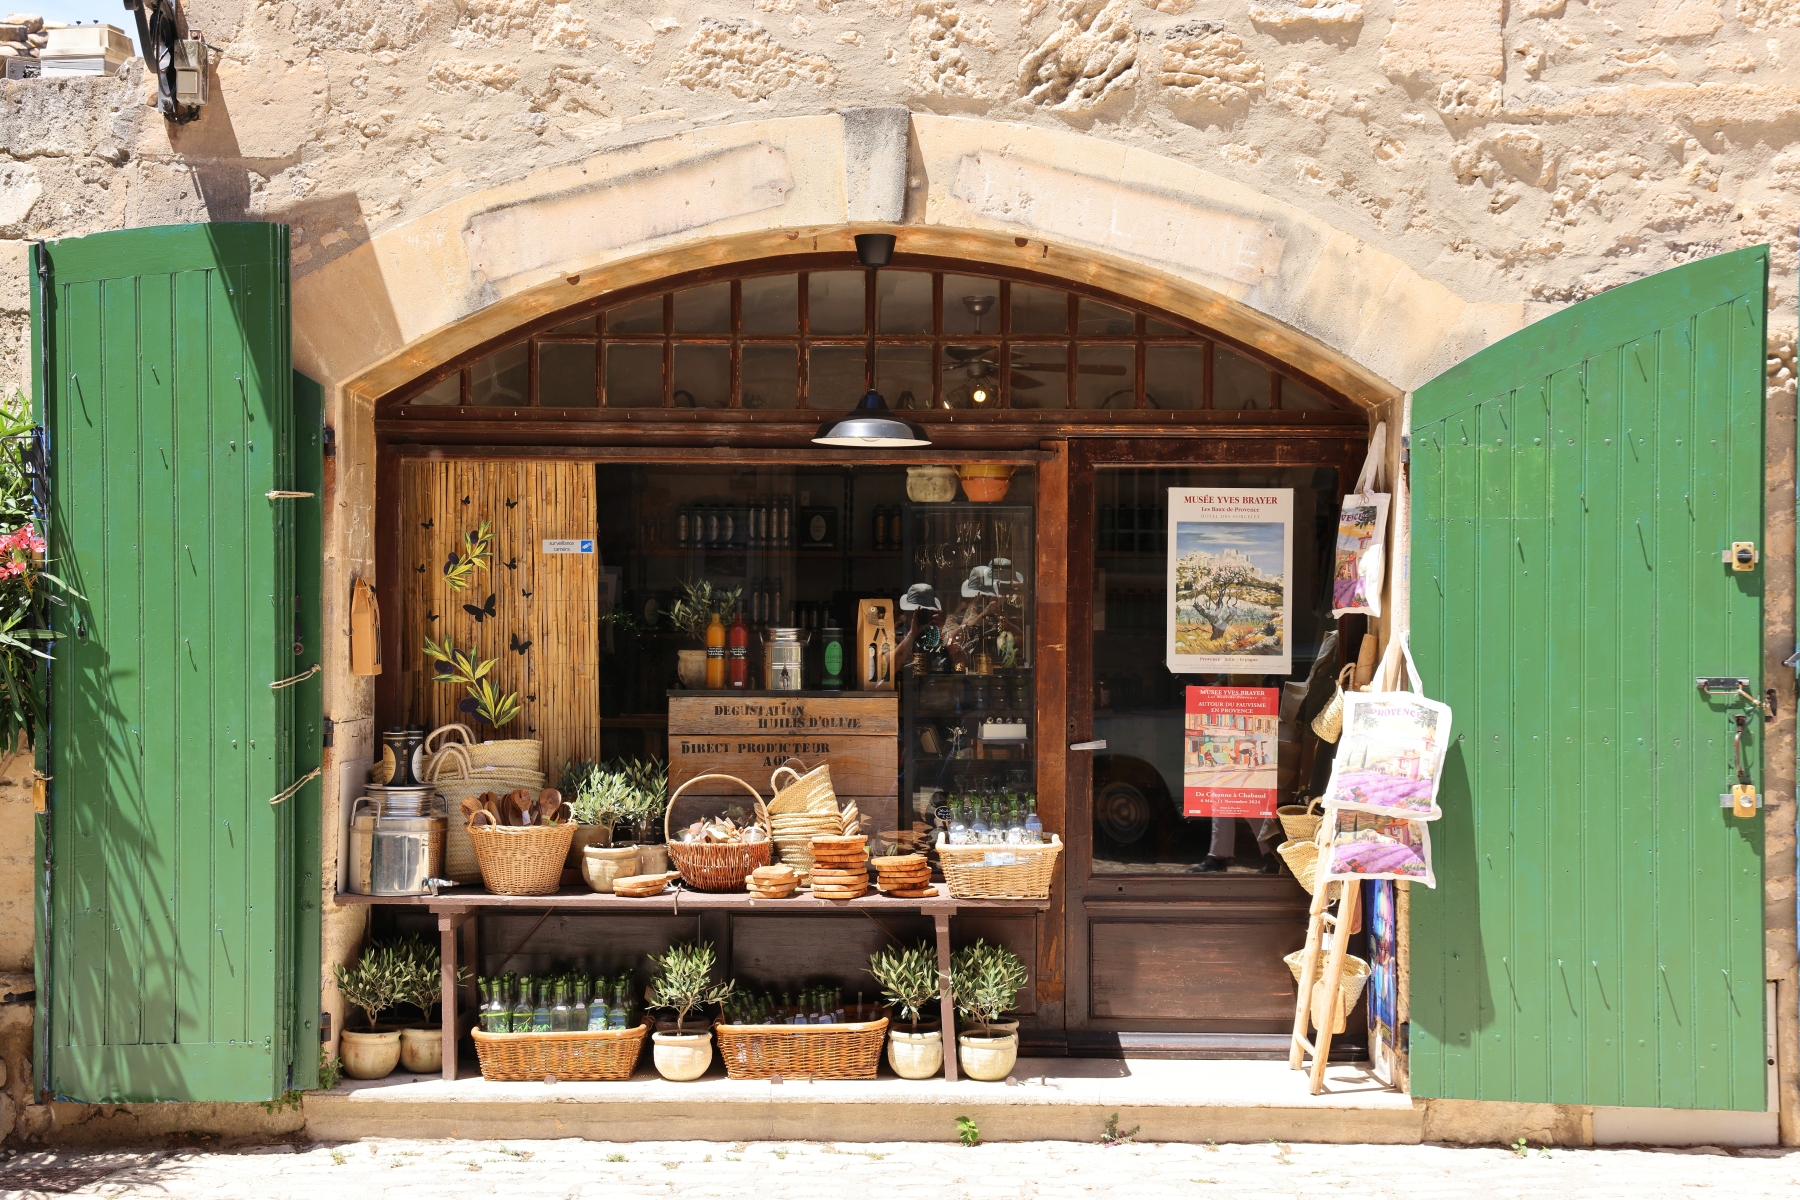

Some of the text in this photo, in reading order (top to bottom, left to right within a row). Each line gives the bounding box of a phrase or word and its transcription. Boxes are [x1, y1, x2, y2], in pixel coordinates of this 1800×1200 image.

[1184, 494, 1278, 505] MUSÉE YVES BRAYER
[714, 704, 804, 717] DEGUSTATION
[1370, 707, 1422, 719] PROVENCE
[681, 742, 830, 755] DIRECT PRODUCTEUR
